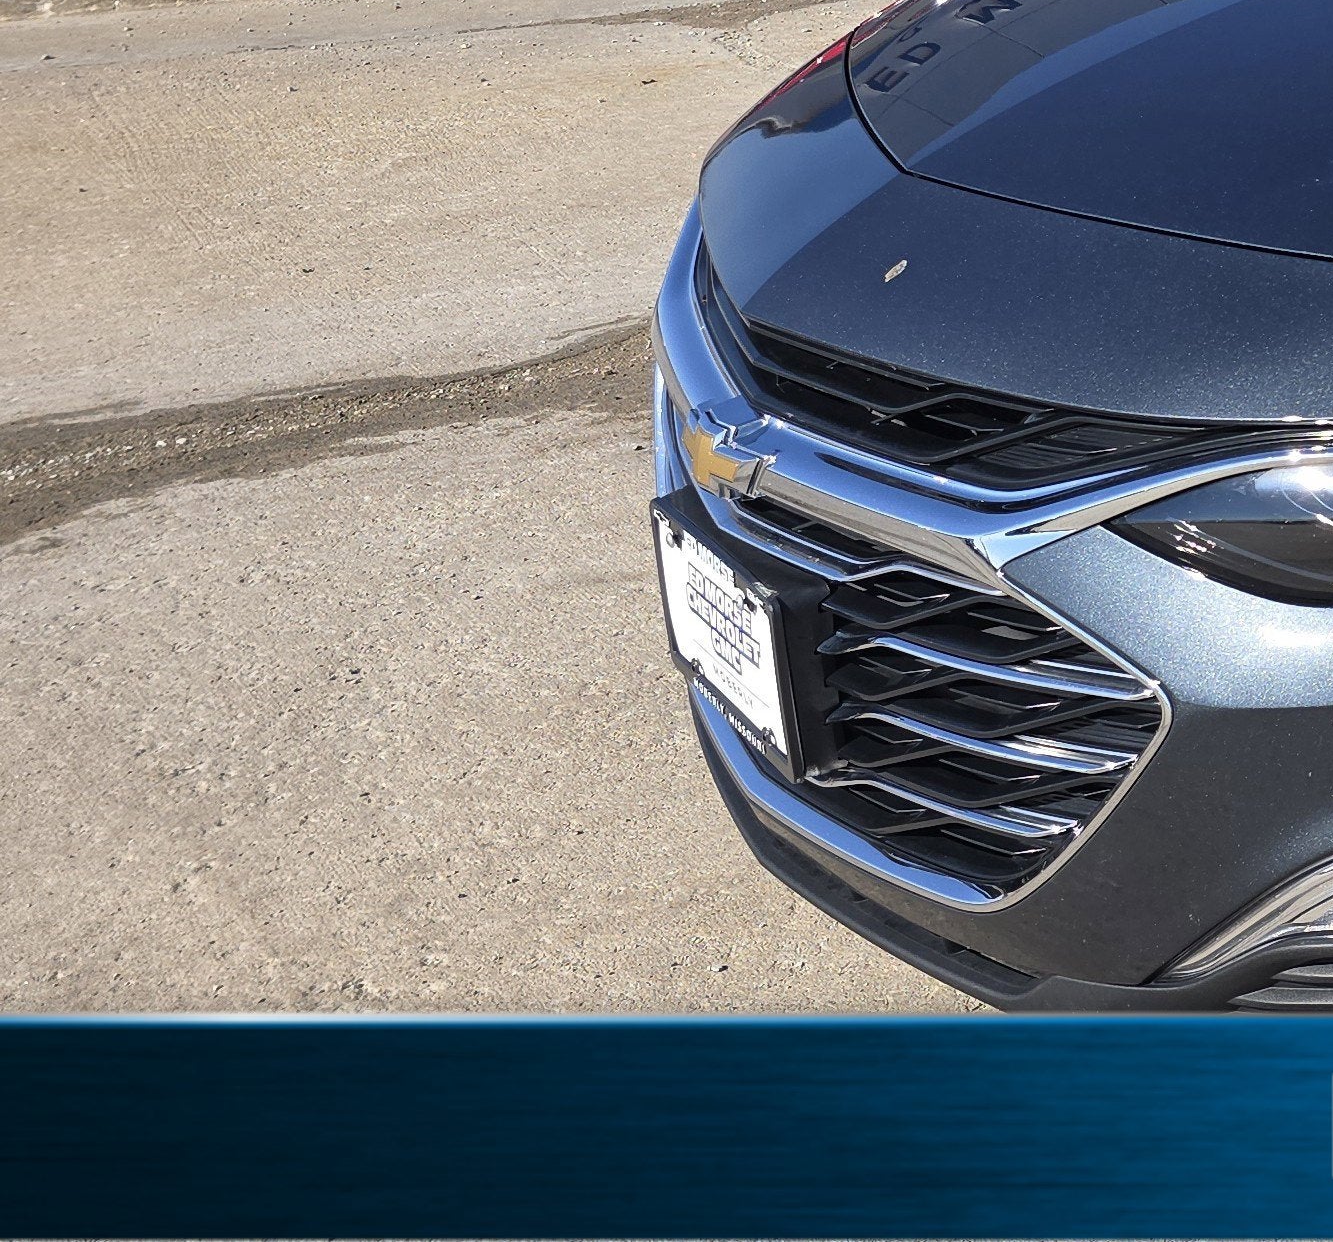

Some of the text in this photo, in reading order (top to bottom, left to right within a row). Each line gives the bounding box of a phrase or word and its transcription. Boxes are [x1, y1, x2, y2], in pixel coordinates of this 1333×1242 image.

[685, 582, 761, 669] CHEVROLET
[687, 561, 752, 636] ED MORSE
[710, 625, 742, 676] GMC
[728, 712, 767, 755] MISSOURI
